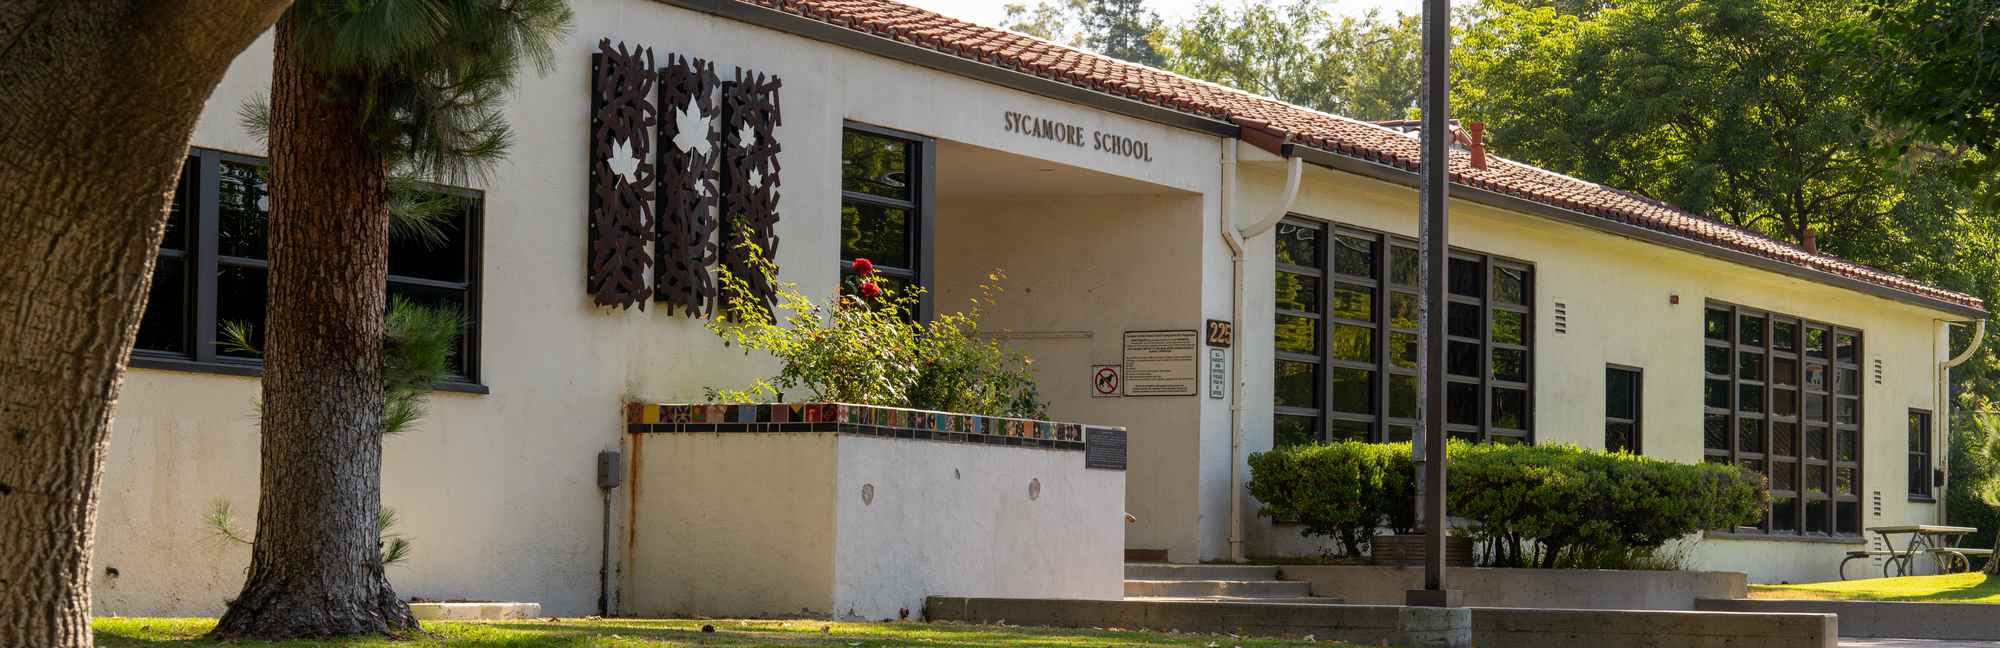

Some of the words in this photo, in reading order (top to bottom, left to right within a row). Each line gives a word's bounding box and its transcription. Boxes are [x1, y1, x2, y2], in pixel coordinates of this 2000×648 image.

[1004, 111, 1085, 147] SYCAMORE
[1094, 130, 1153, 162] SCHOOL
[1209, 321, 1232, 344] 225
